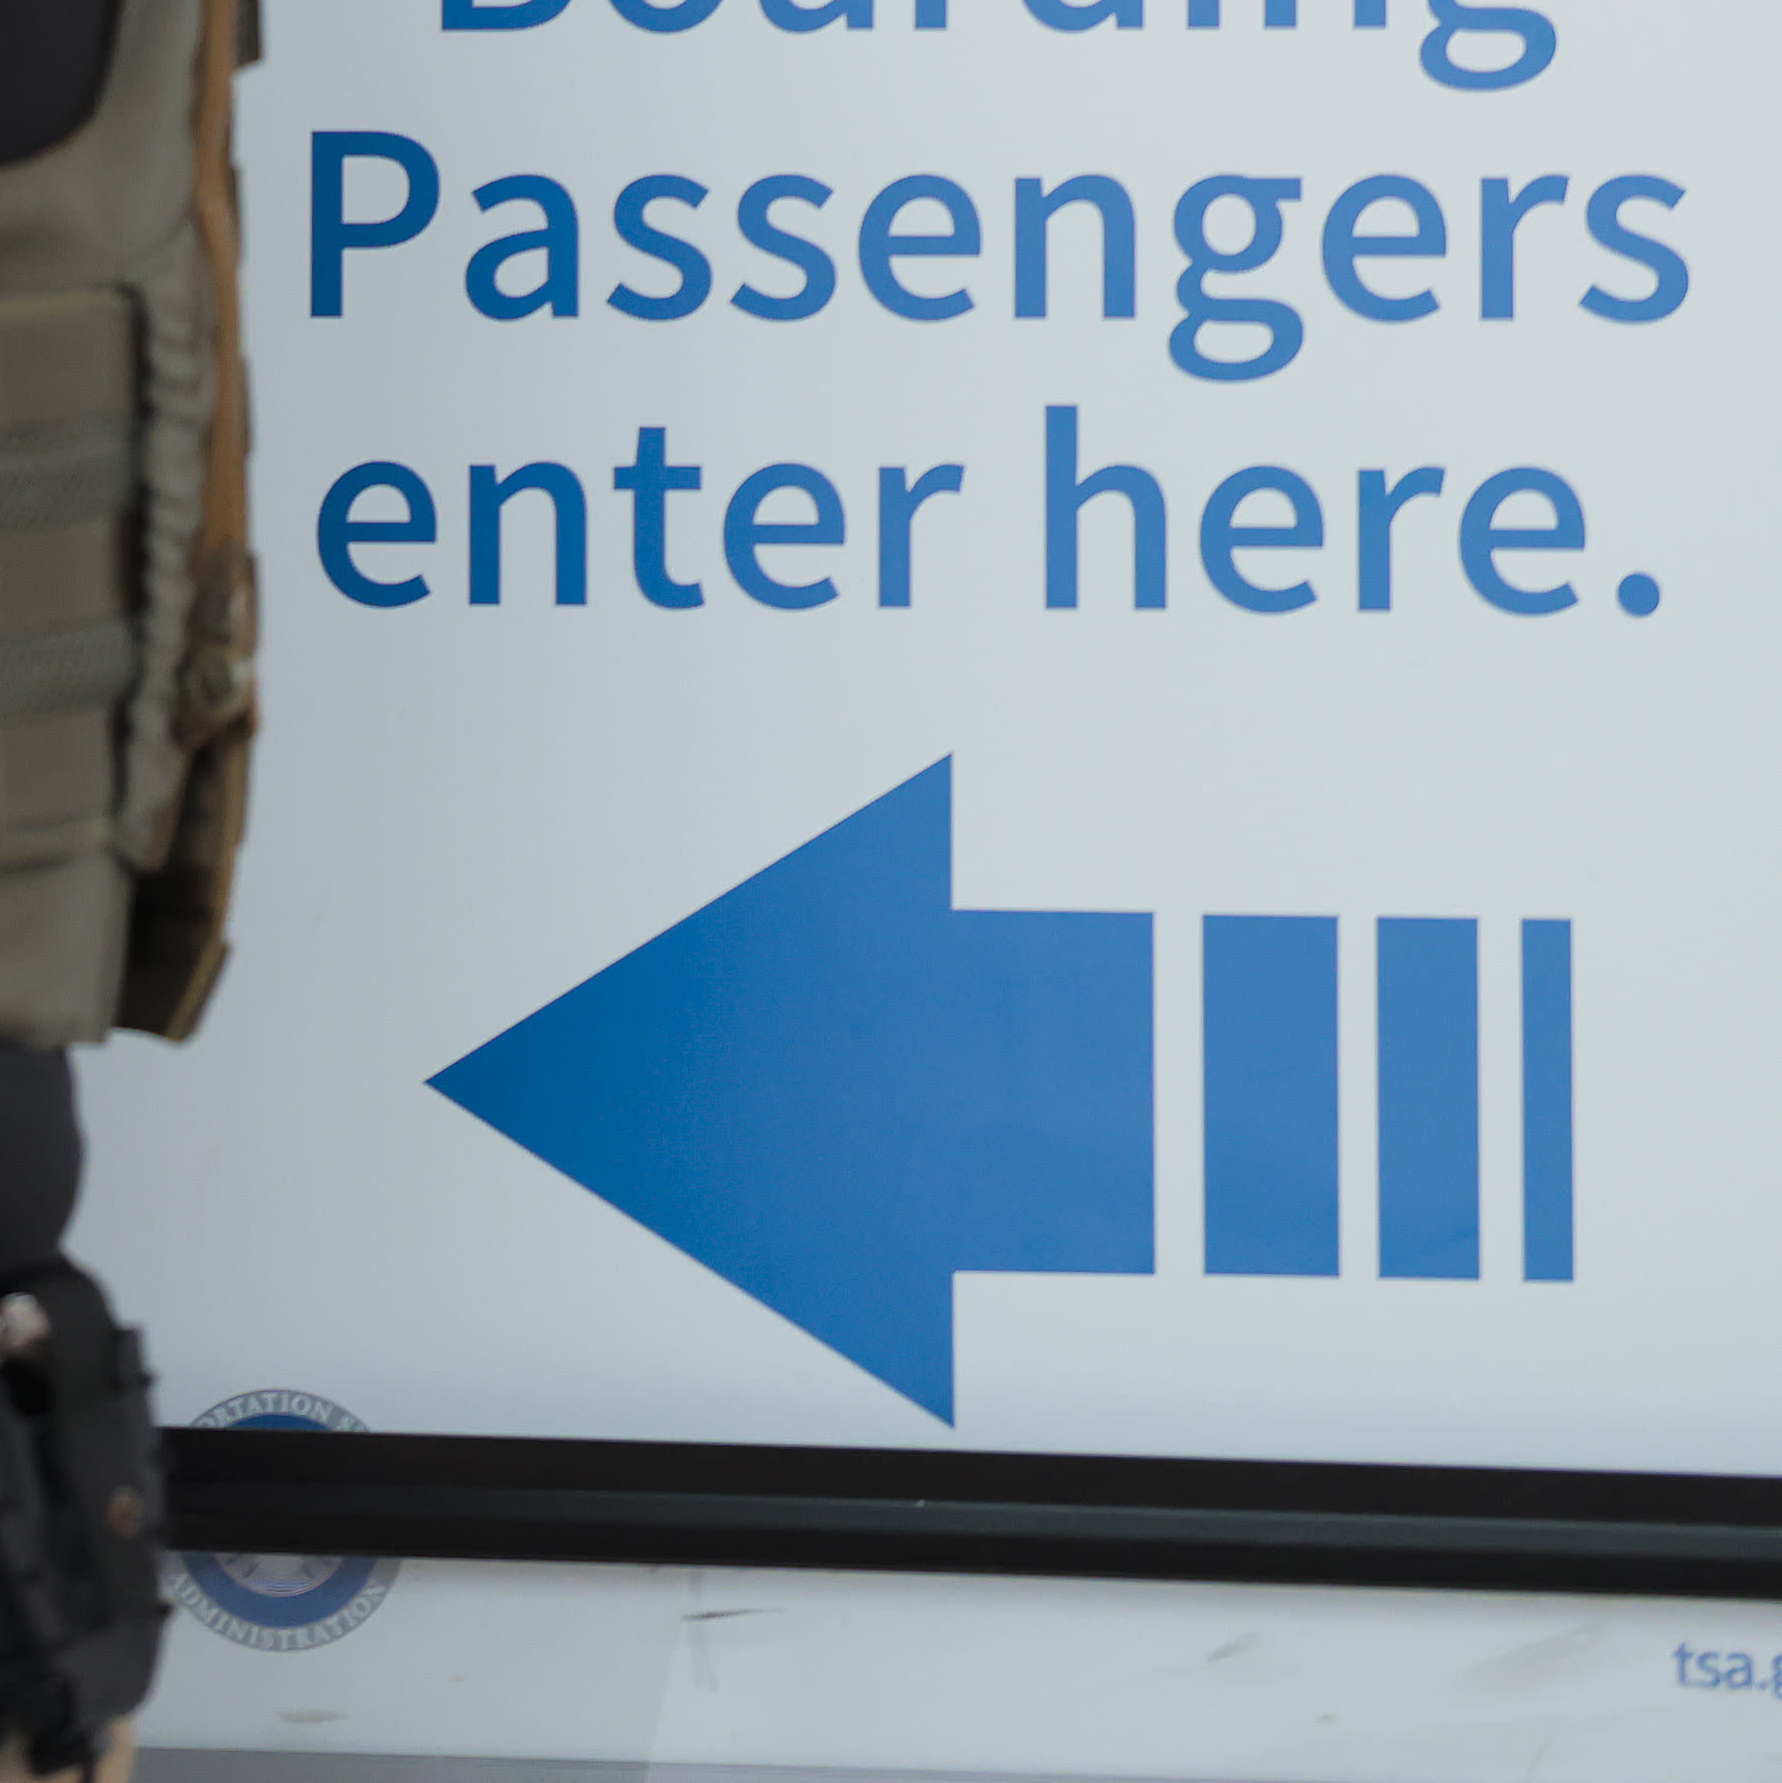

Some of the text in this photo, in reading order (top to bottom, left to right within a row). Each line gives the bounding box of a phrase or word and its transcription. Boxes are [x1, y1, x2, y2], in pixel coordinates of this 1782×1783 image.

[312, 132, 1689, 381] Passengers
[319, 406, 1659, 617] enter here.
